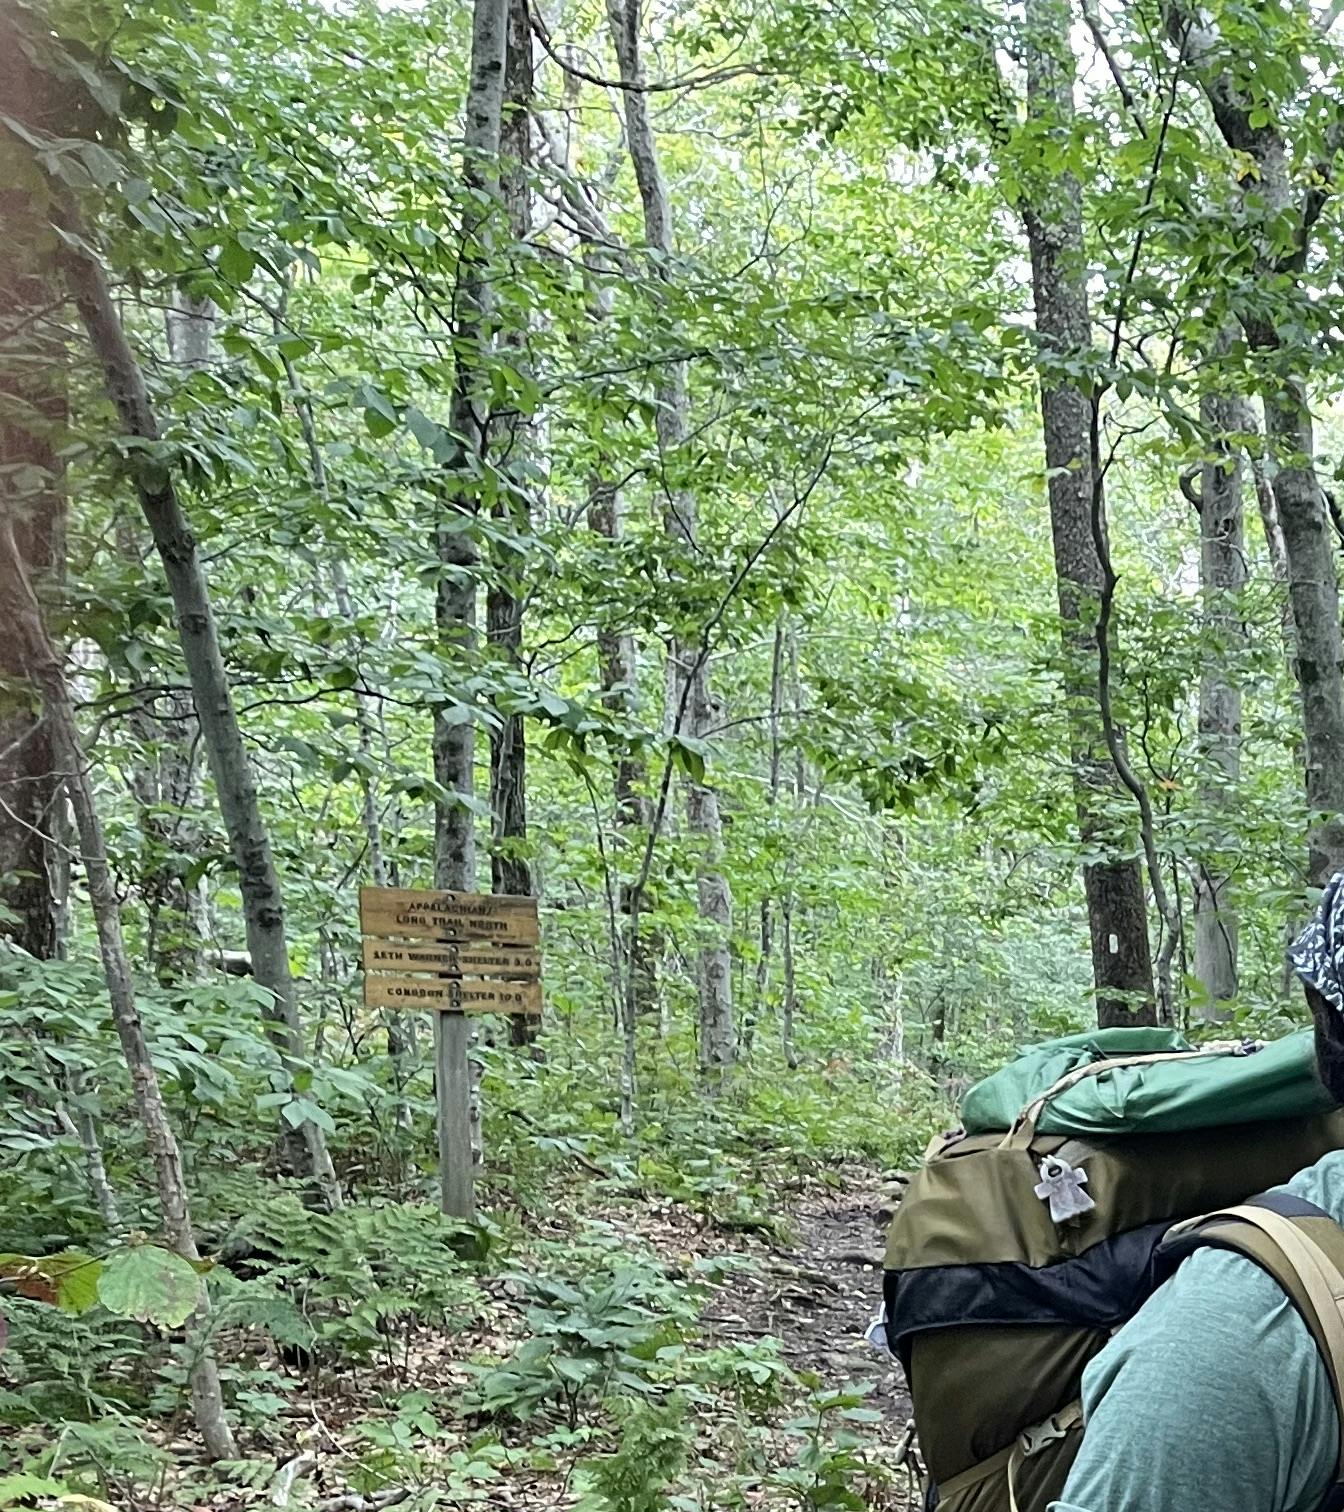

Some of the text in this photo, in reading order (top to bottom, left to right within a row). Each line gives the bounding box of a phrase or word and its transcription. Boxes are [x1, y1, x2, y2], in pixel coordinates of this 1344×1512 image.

[395, 915, 509, 931] LONG TRAIL NORTH
